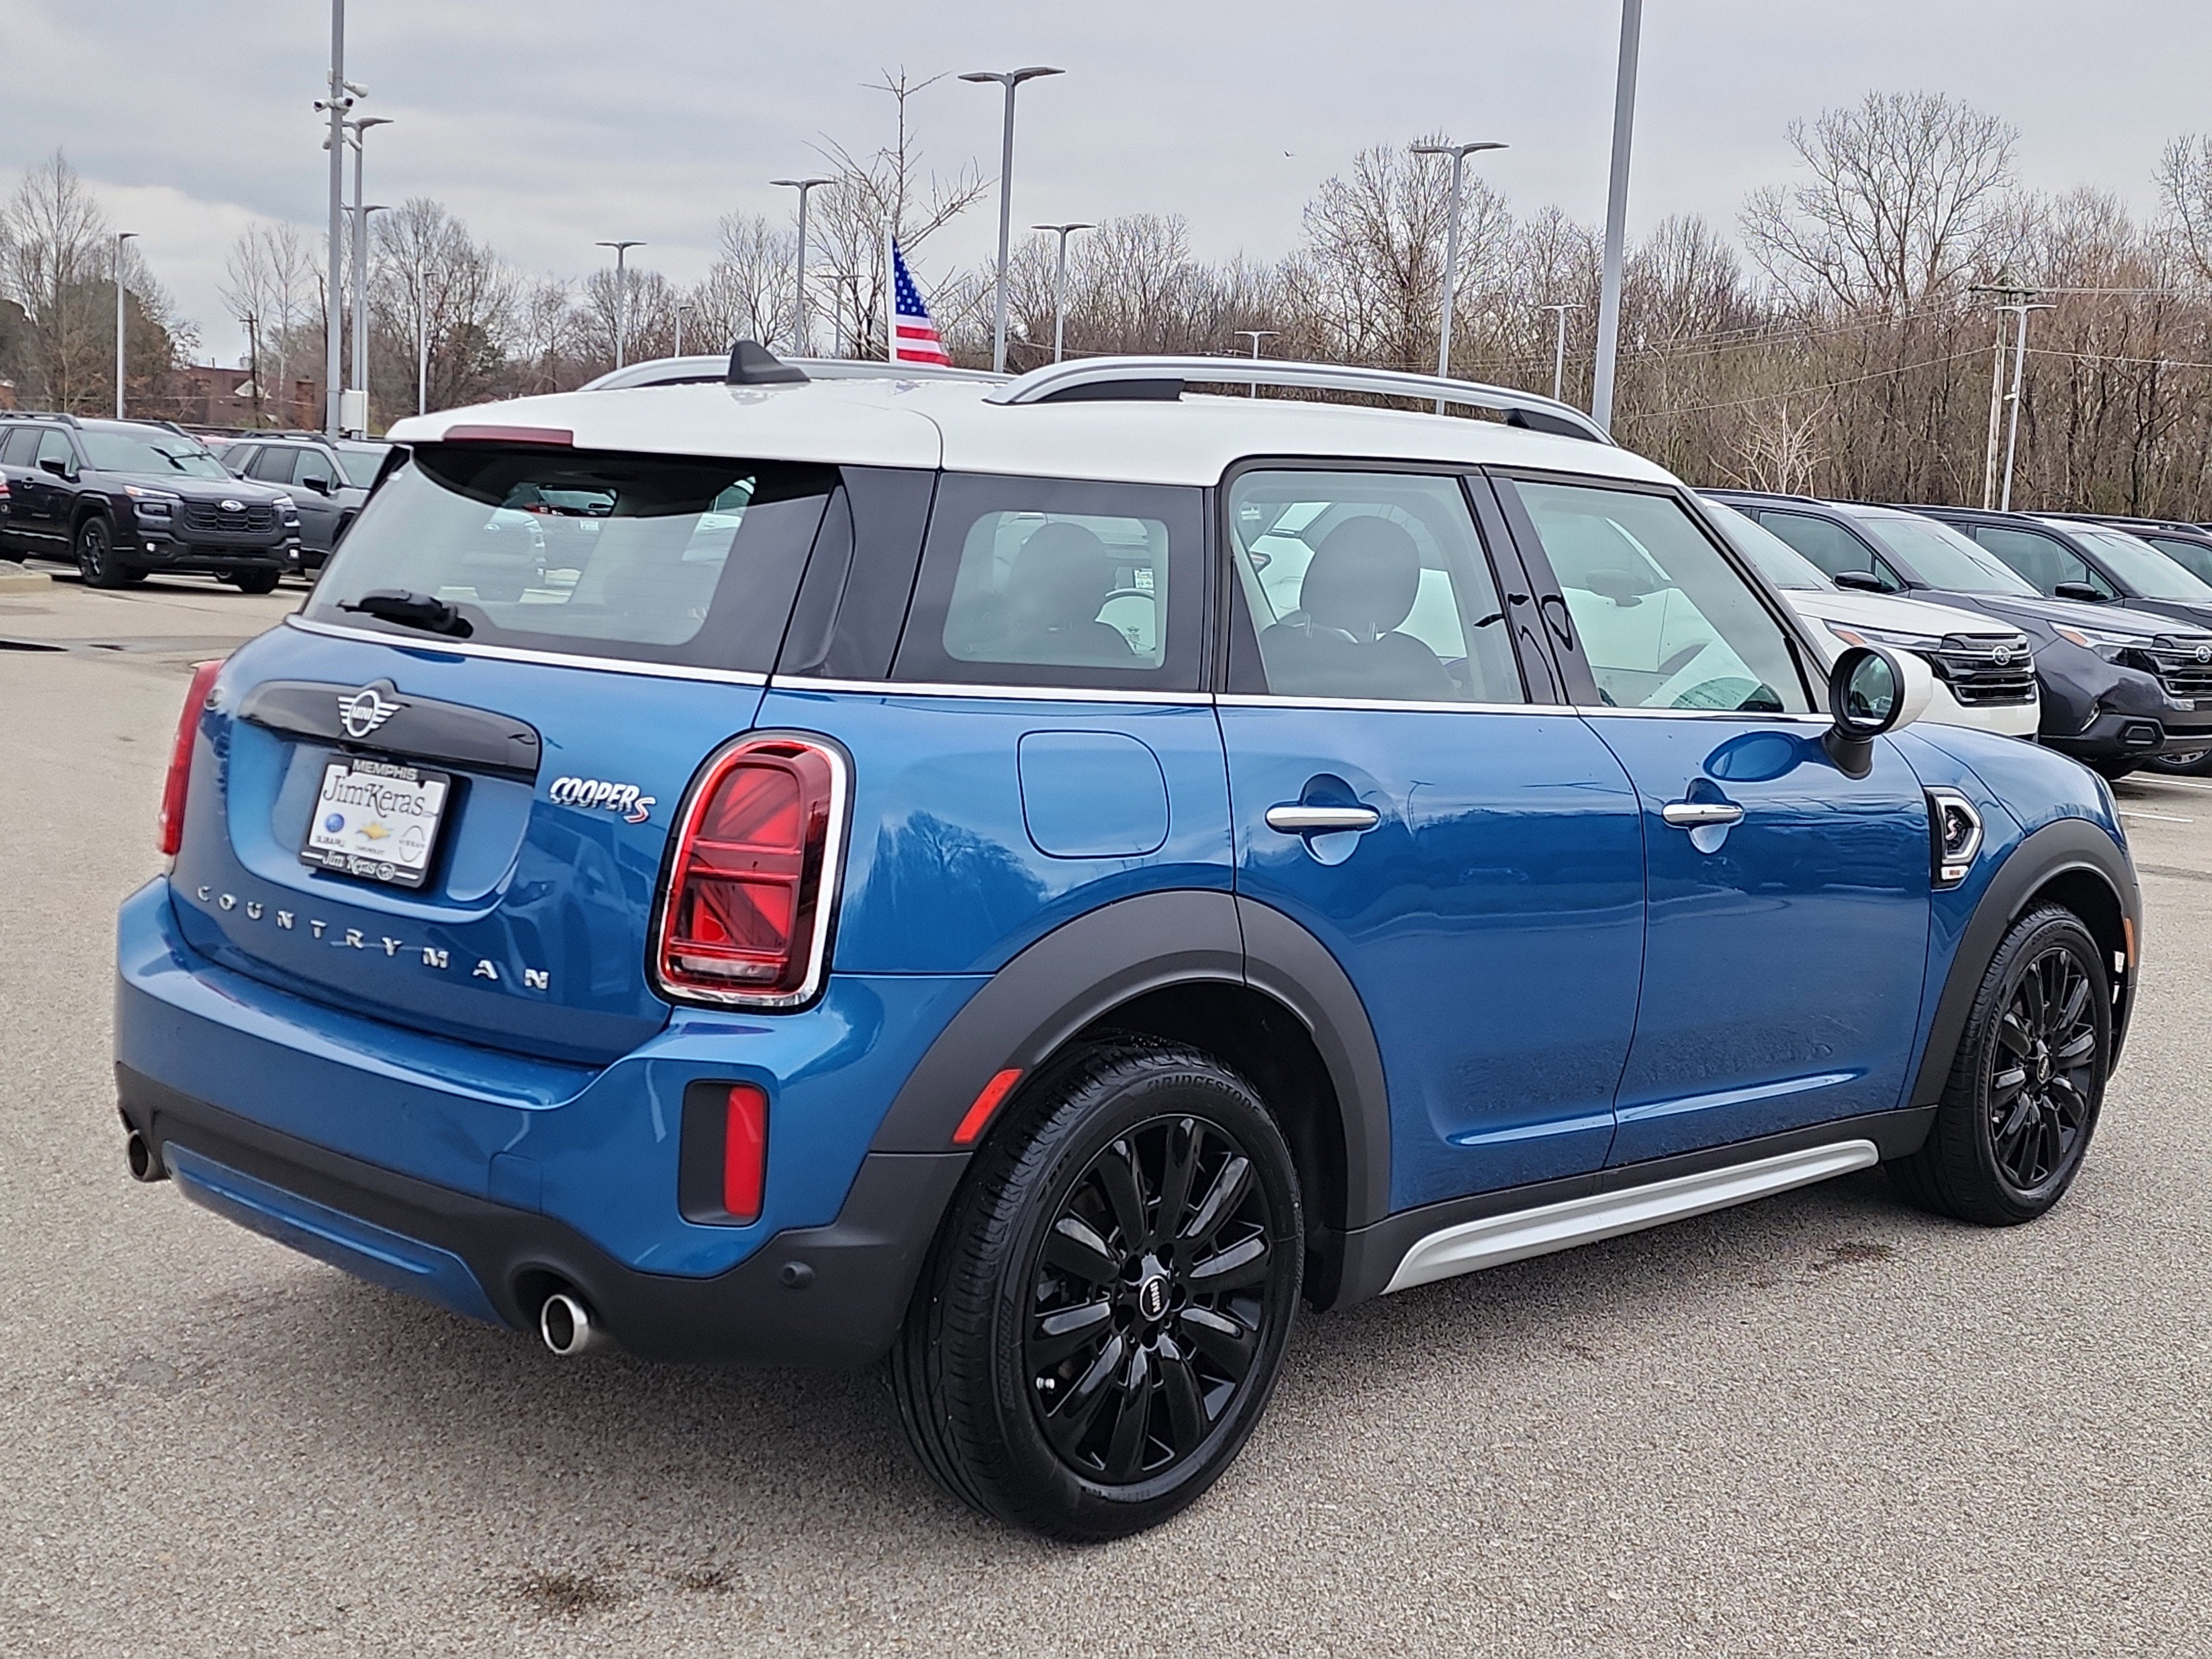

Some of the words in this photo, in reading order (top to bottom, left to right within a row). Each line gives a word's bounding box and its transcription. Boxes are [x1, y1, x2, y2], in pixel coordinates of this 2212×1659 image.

[352, 706, 373, 720] MINI
[352, 759, 419, 780] MEMPHIS
[322, 851, 345, 867] Jim
[347, 855, 377, 875] Keras
[197, 885, 549, 990] COUNTRYMAN
[1150, 1281, 1161, 1313] MINI
